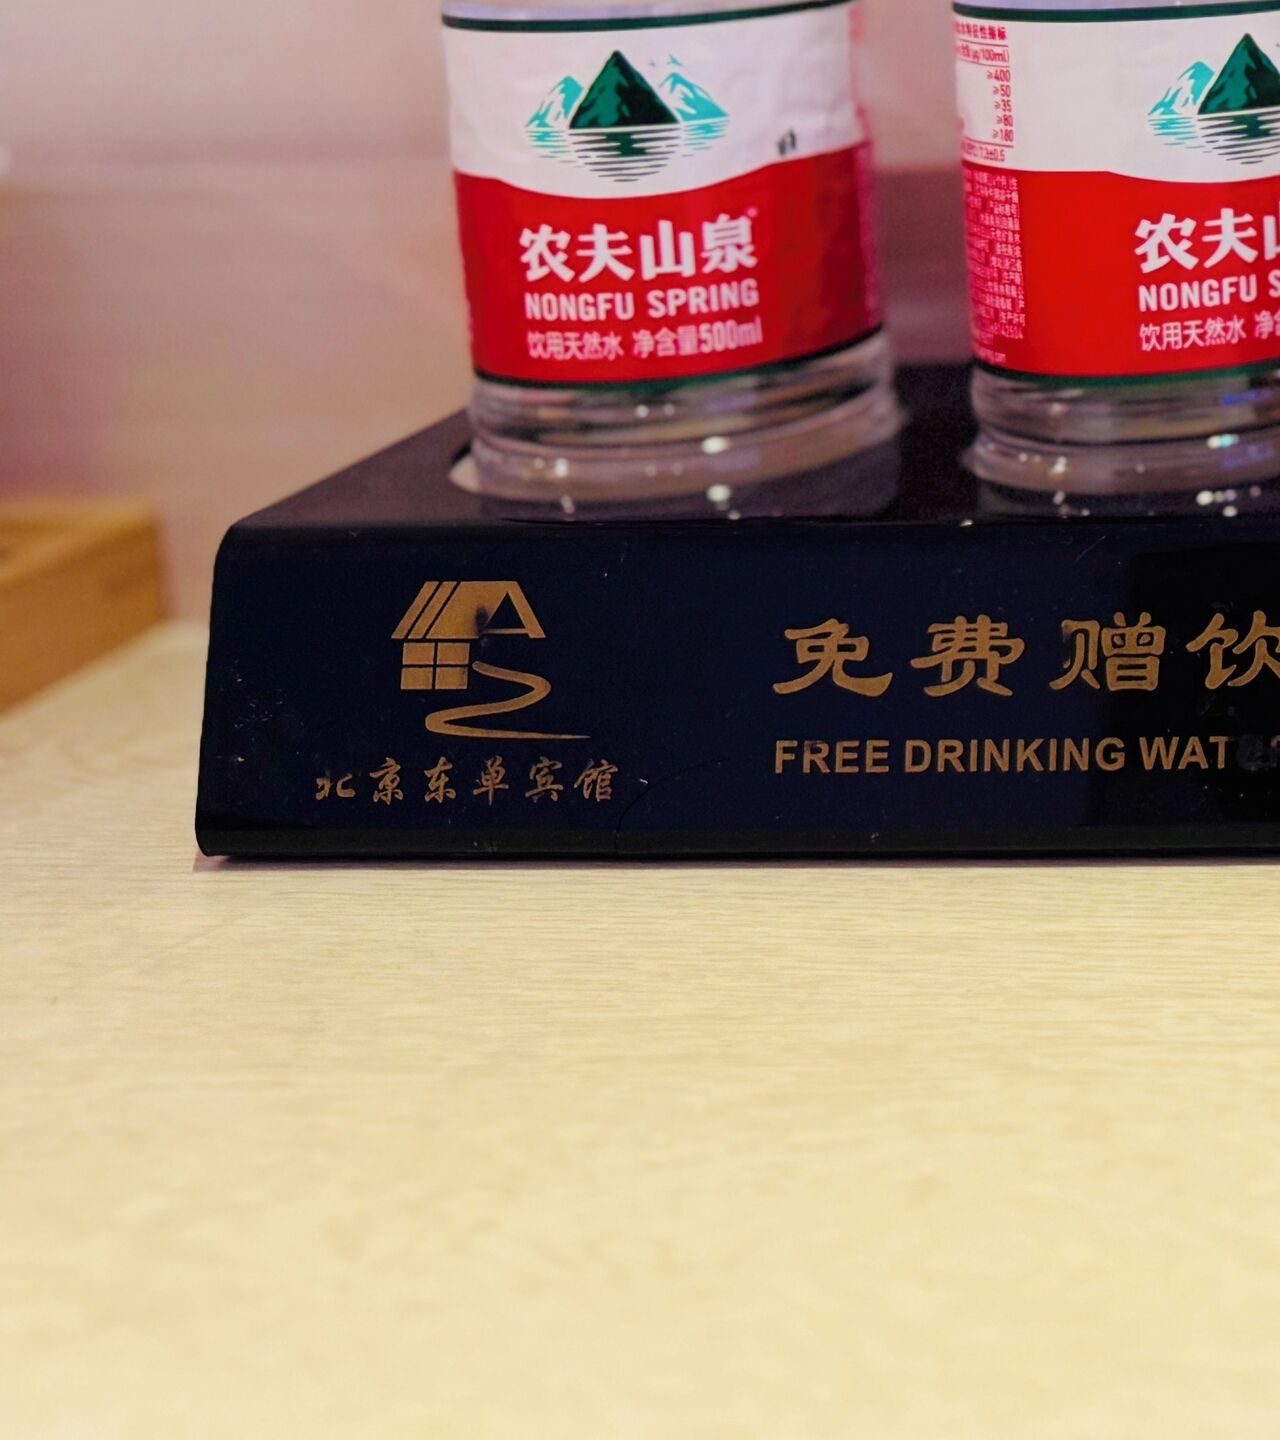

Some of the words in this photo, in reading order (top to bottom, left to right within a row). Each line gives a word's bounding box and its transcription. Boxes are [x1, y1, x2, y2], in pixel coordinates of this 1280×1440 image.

[519, 213, 758, 283] 农夫山泉
[524, 292, 635, 322] NONGFU
[646, 278, 760, 319] SPRING
[1138, 274, 1257, 313] NONGFU
[526, 330, 625, 361] 饮用天然水
[1139, 314, 1247, 352] 饮用天然水
[775, 739, 891, 773] FREE
[905, 736, 1126, 773] DRINKING
[315, 755, 620, 805] 北京东单宾馆
